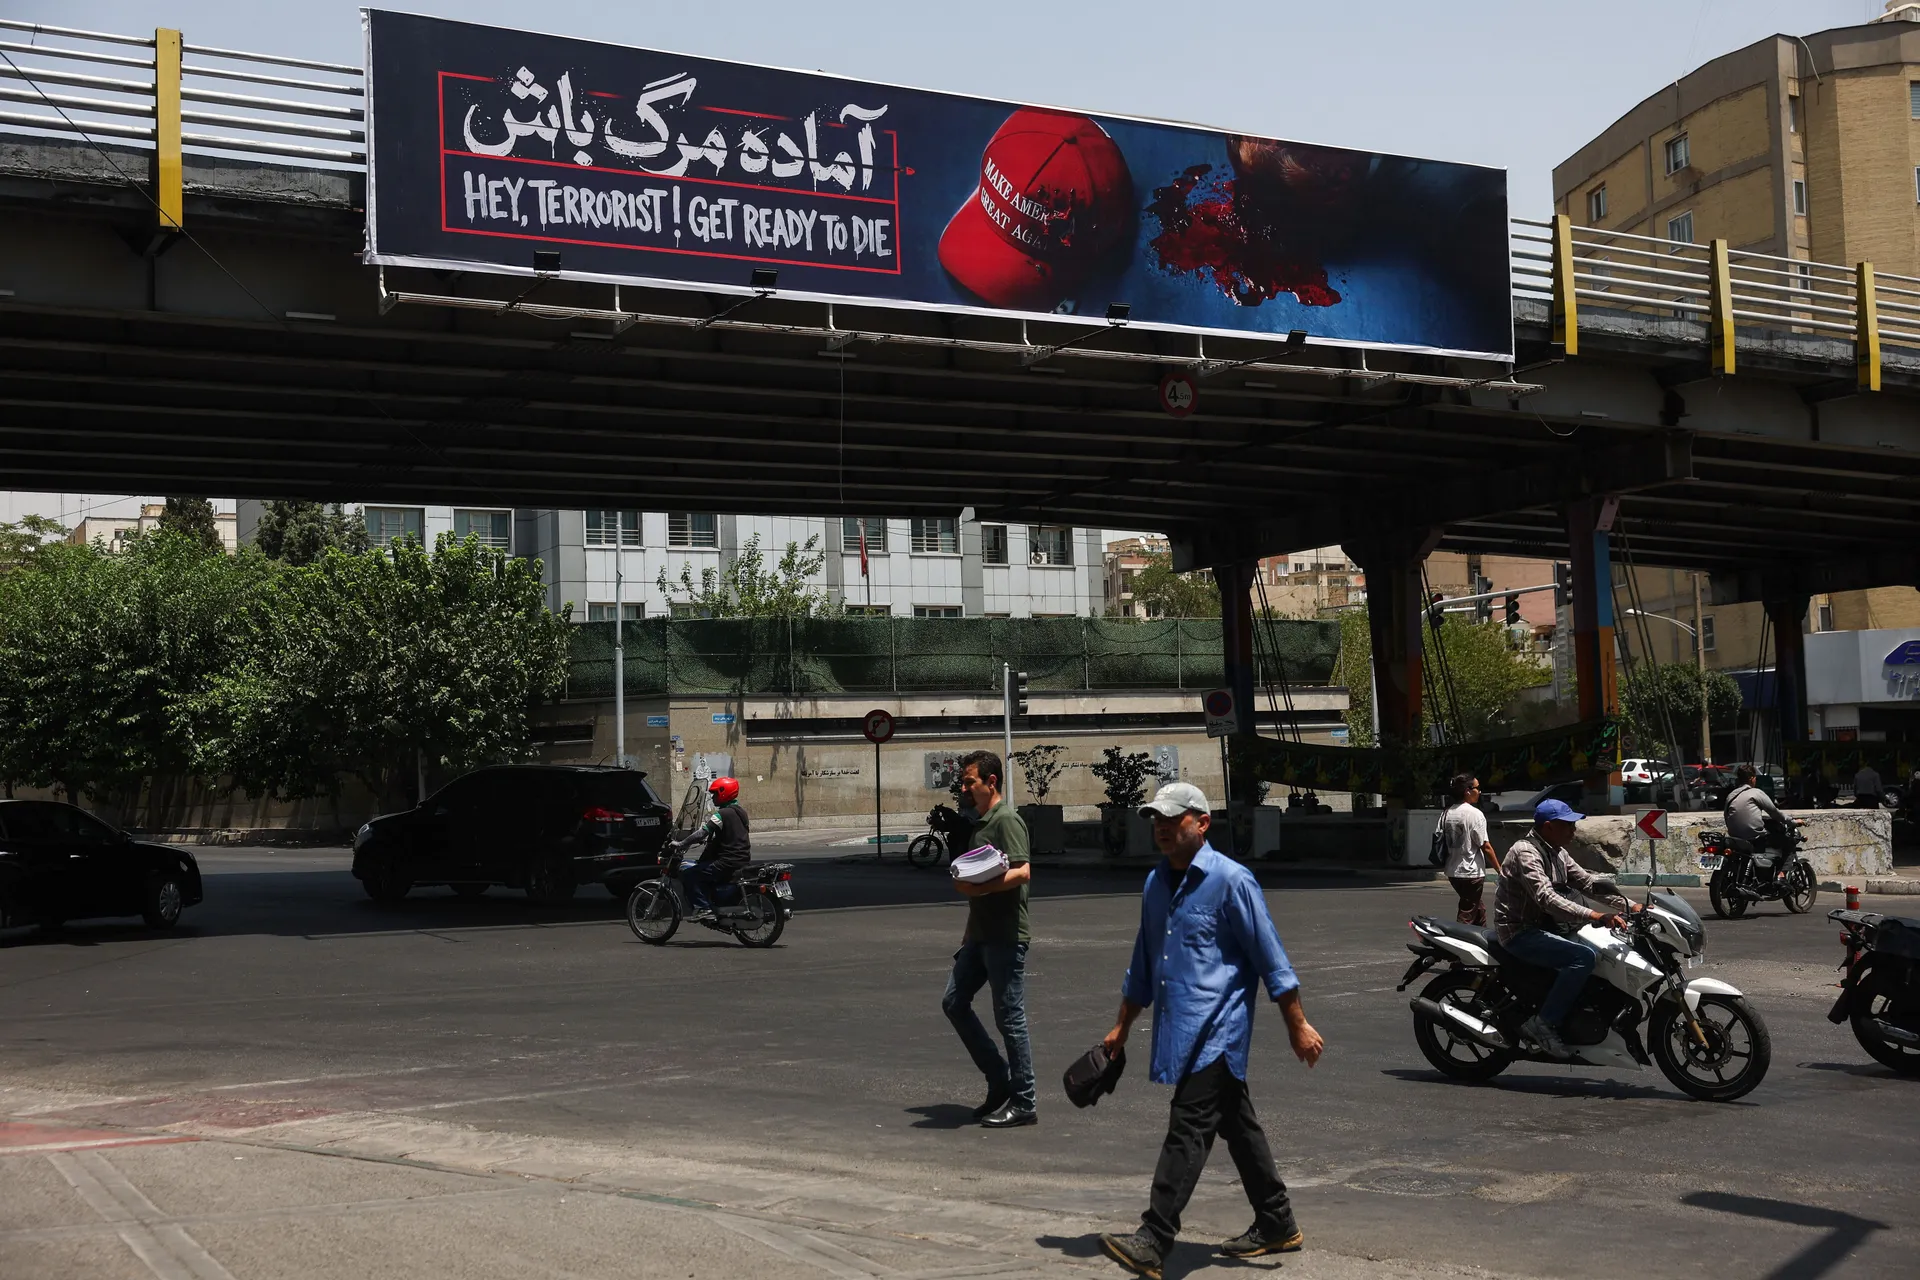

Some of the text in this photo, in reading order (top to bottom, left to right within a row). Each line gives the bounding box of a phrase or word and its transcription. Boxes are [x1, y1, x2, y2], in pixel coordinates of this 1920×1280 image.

[463, 66, 889, 192] آماده مرگ باش
[463, 170, 529, 227] HEY,
[688, 196, 741, 243] GET
[742, 204, 818, 251] READY
[820, 214, 848, 256] TO
[852, 215, 892, 260] DIE
[980, 187, 1011, 230] GREAT
[983, 157, 1051, 226] MAKE AMER
